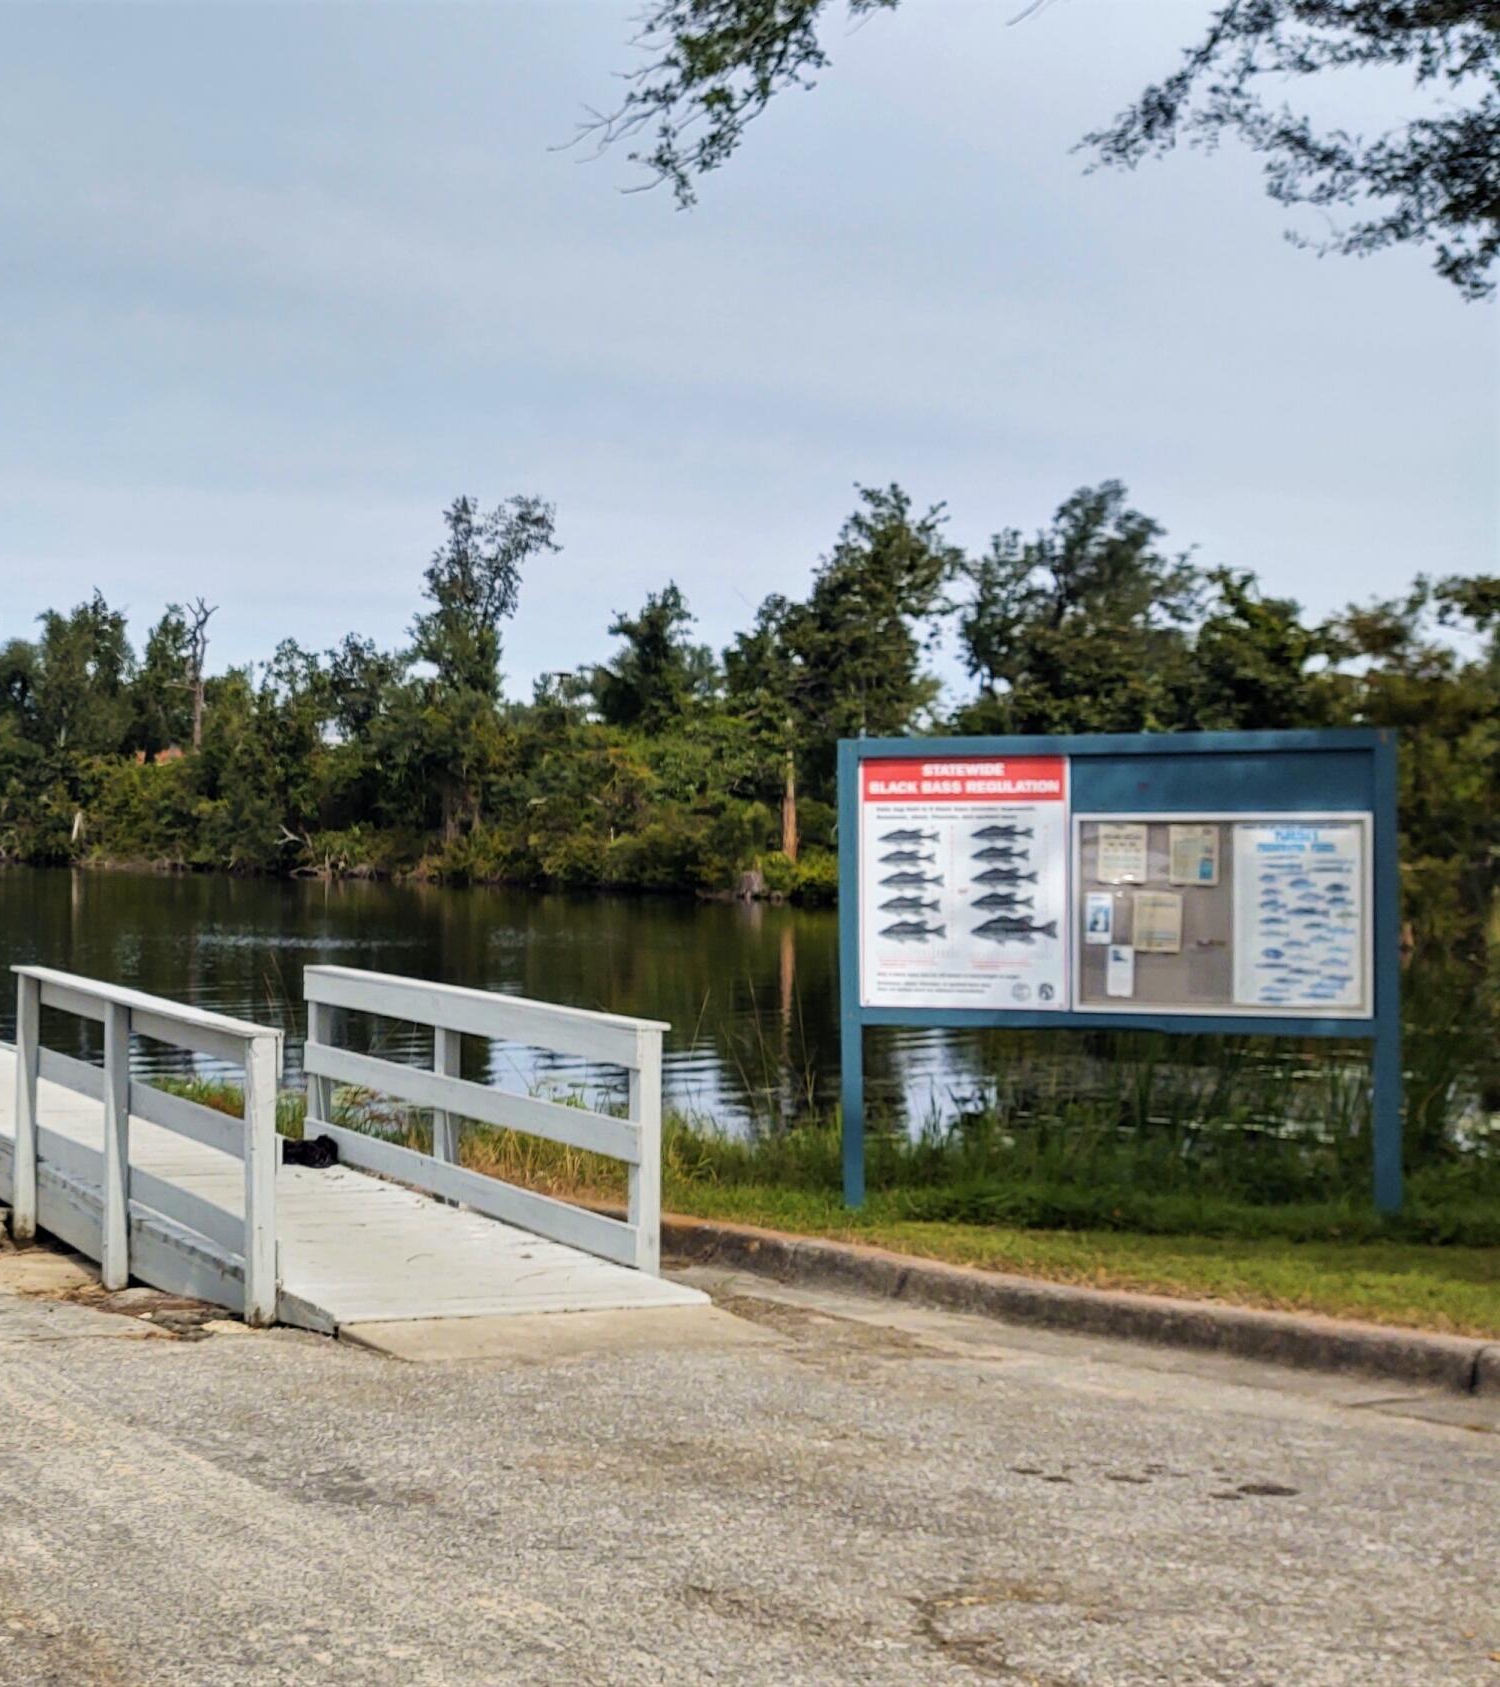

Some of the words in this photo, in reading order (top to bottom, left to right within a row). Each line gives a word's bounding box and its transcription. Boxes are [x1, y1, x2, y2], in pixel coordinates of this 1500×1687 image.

[921, 762, 1005, 777] STATEWIDE
[868, 780, 918, 795] BLACK
[921, 780, 963, 795] BASS
[965, 779, 1060, 795] REGULATION
